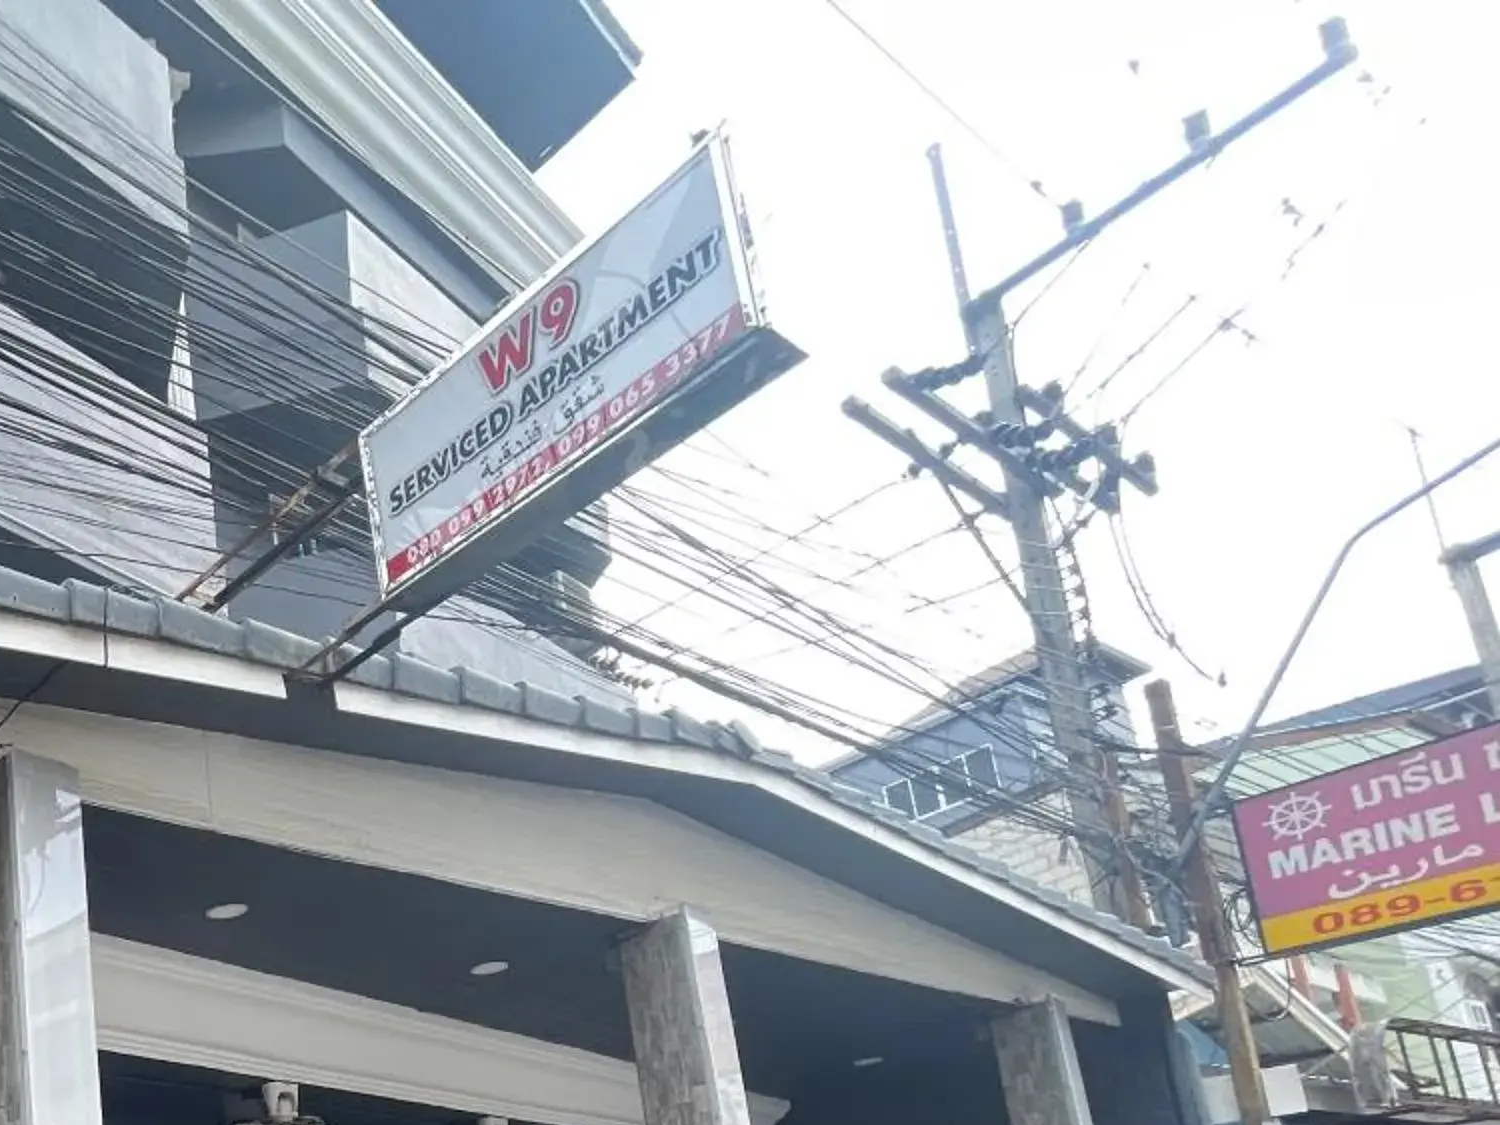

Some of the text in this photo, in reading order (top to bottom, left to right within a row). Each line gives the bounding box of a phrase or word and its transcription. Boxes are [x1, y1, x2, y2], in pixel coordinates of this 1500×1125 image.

[388, 230, 722, 515] SERVICED APARTMENT
[477, 277, 579, 394] W9
[610, 373, 655, 417] 065
[664, 311, 732, 377] 3377
[1351, 751, 1465, 811] มารีน
[1268, 804, 1460, 880] MARINE
[1328, 843, 1485, 900] مارين
[1312, 877, 1500, 934] 089-6
